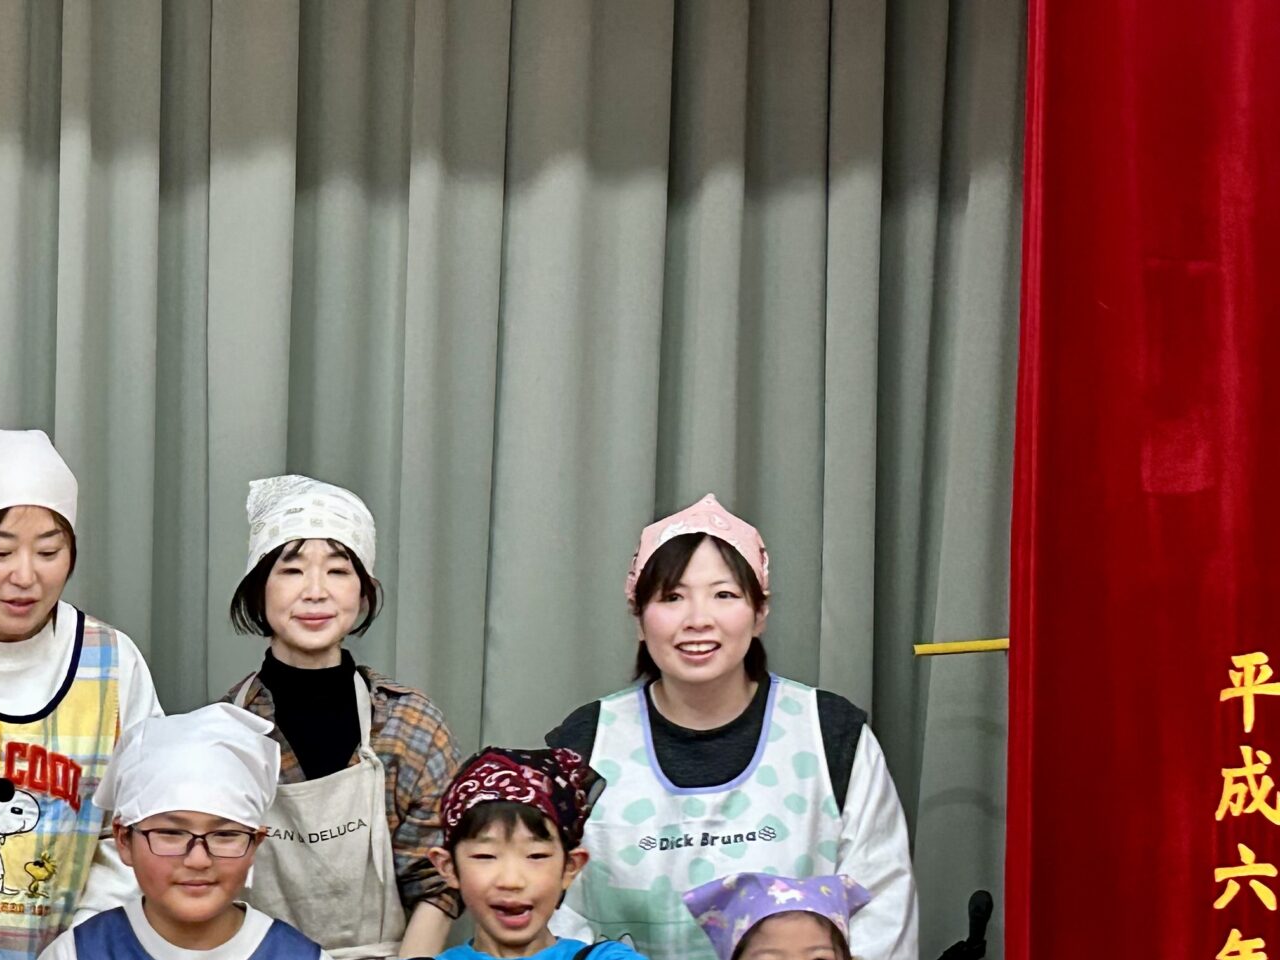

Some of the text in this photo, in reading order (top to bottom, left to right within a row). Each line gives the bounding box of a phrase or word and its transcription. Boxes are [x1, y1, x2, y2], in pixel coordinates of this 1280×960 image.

[4, 741, 82, 812] COOL
[308, 818, 367, 844] DELUCA
[659, 831, 757, 851] Dick Bruna
